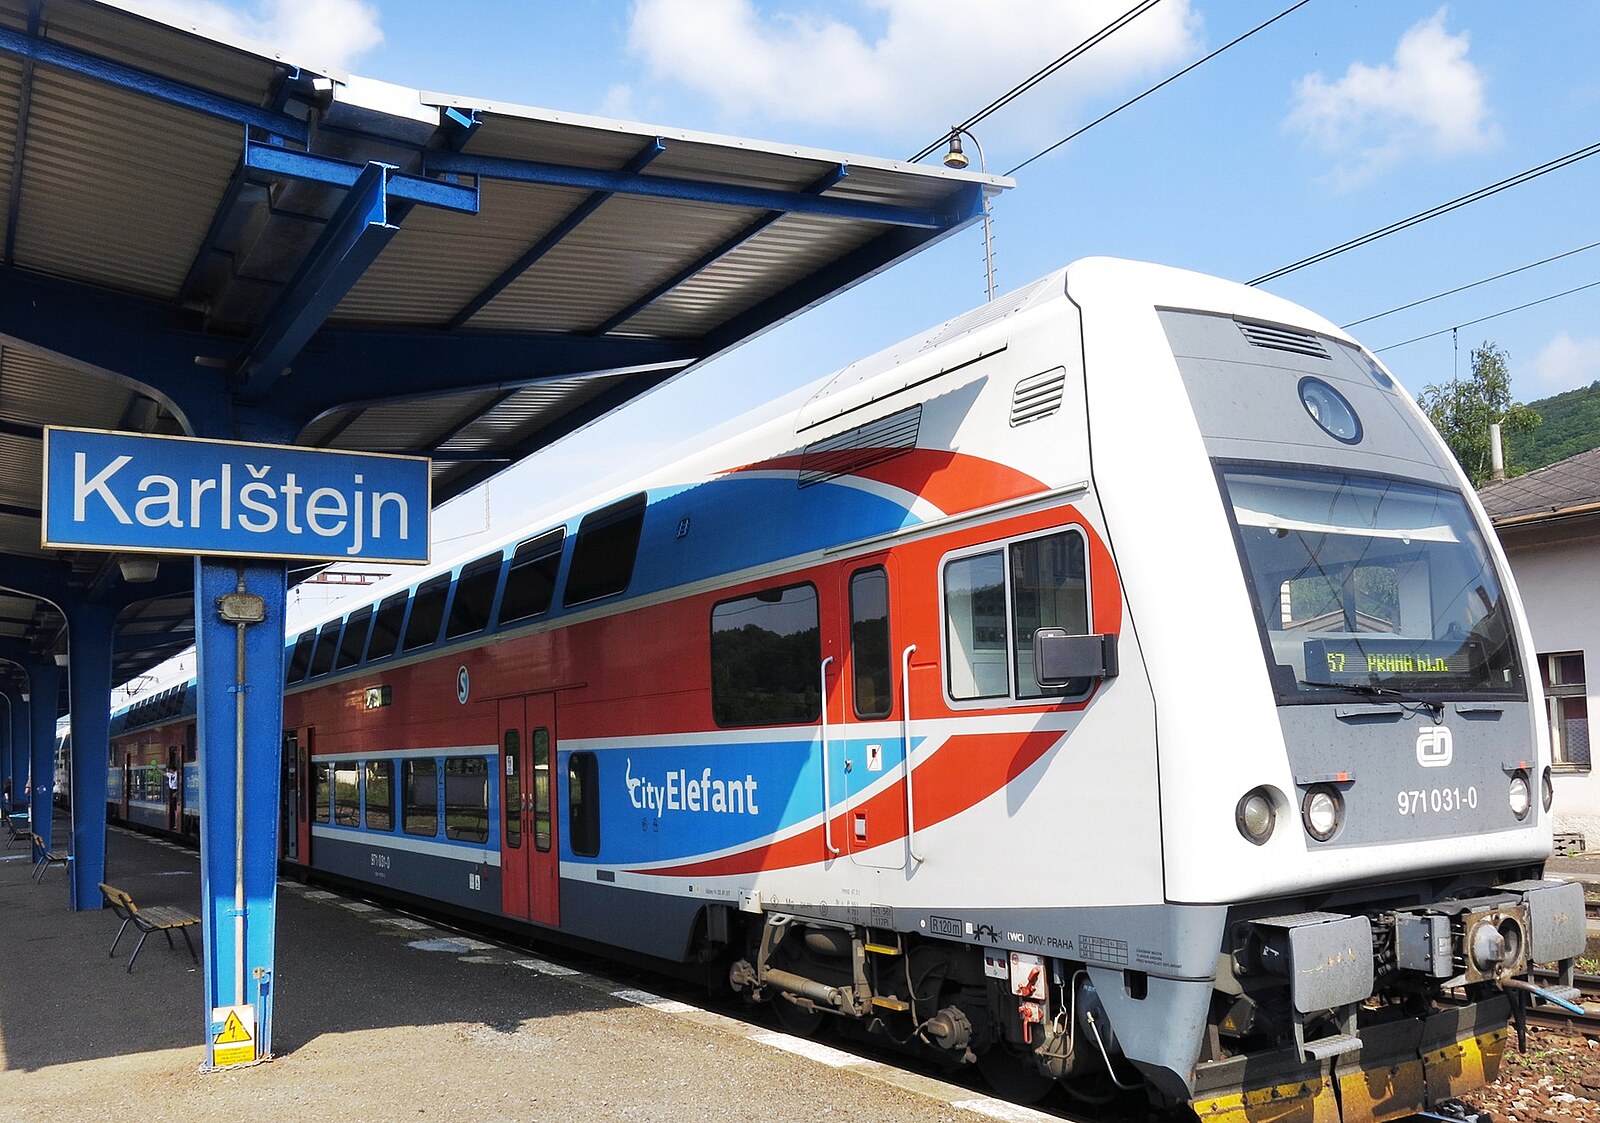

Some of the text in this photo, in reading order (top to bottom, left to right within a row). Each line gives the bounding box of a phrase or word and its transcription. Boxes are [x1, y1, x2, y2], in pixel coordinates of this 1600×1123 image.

[73, 452, 409, 555] Karlštejn
[1326, 653, 1346, 672] 57
[1367, 653, 1414, 673] PRAHA
[1397, 786, 1478, 815] 971 031-0
[1046, 937, 1075, 950] PRAHA
